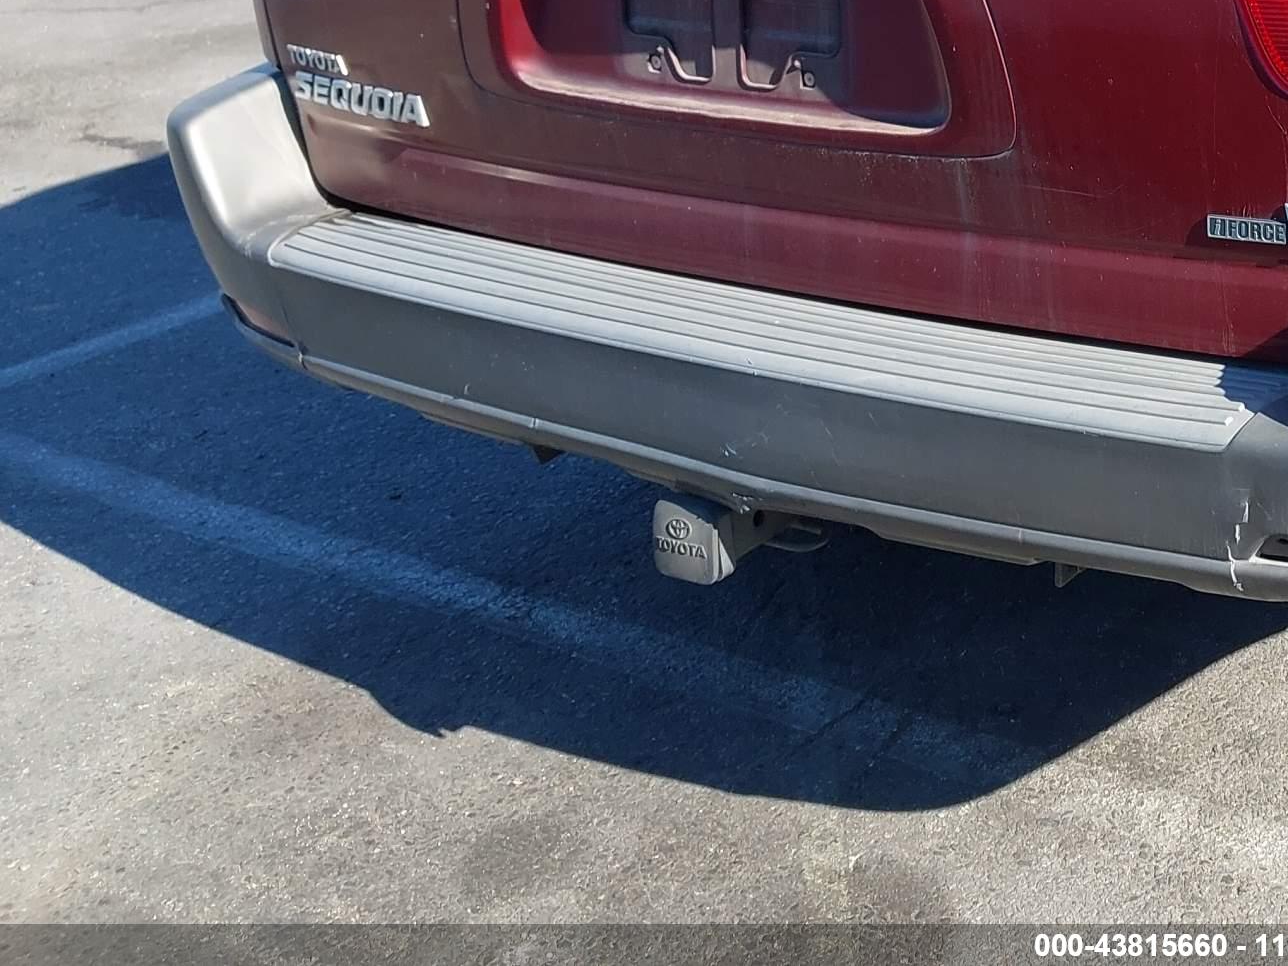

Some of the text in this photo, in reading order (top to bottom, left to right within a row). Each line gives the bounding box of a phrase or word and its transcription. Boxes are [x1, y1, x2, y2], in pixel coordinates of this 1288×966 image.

[287, 44, 348, 76] TOYOTA
[294, 70, 430, 127] SEQUOIA
[656, 536, 707, 559] TOYOTA
